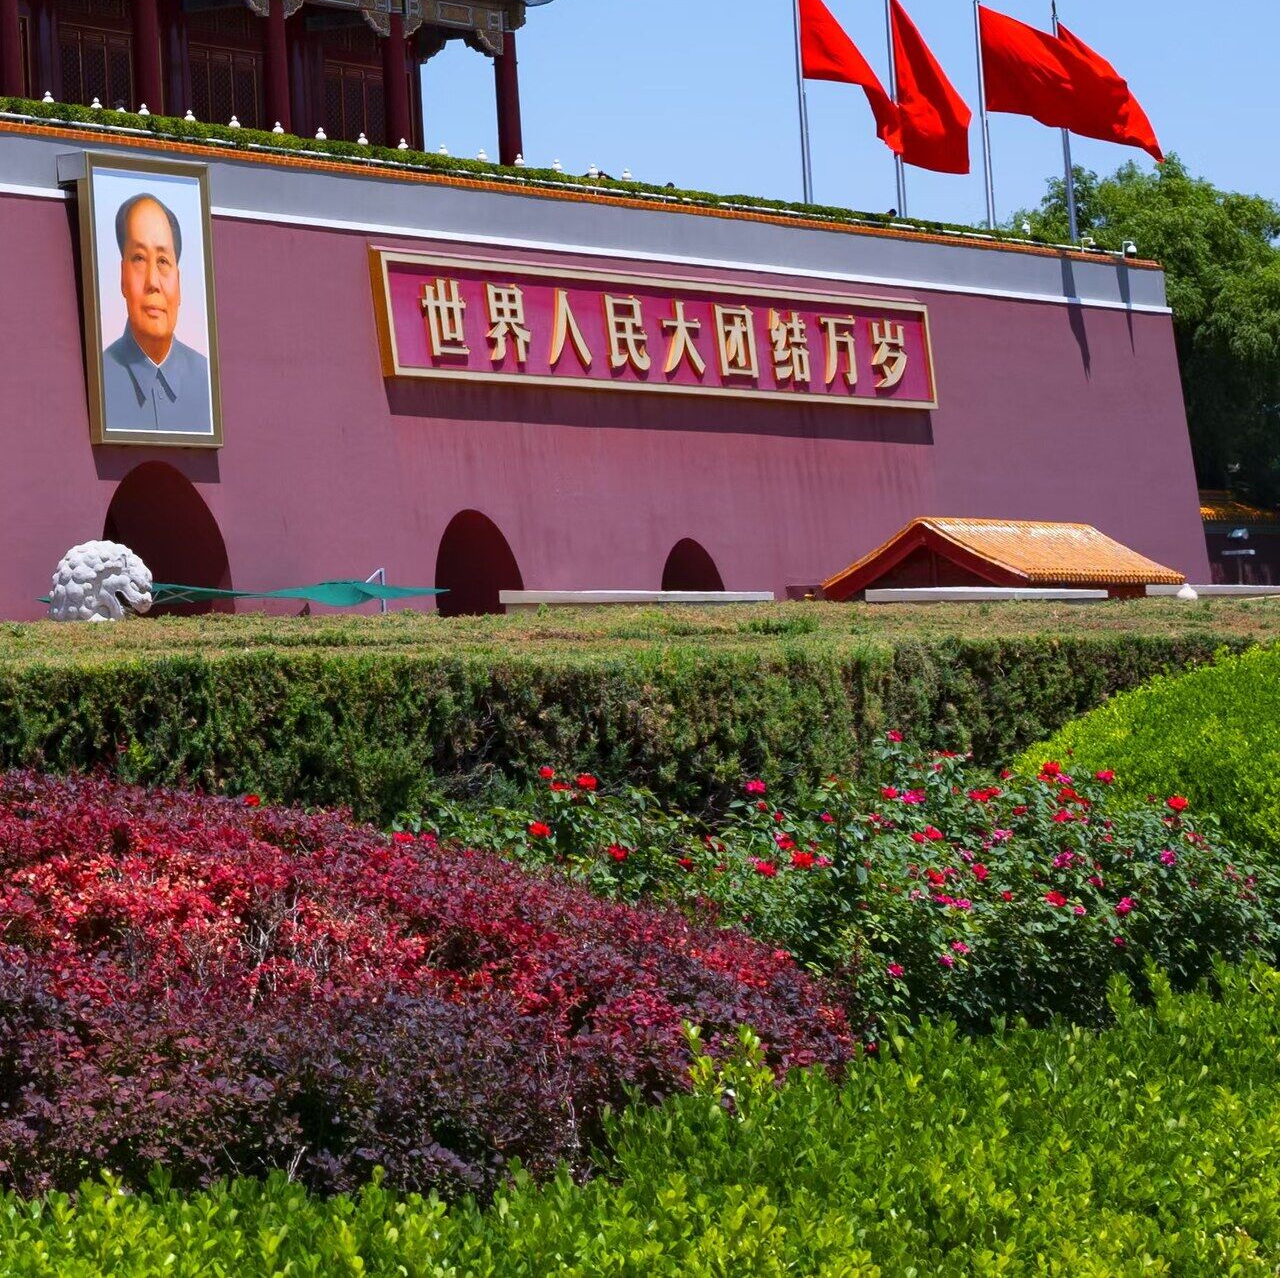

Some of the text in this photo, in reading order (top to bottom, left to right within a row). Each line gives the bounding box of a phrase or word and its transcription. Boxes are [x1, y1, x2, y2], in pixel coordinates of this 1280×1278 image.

[421, 278, 908, 388] 世界人民大团结万岁
